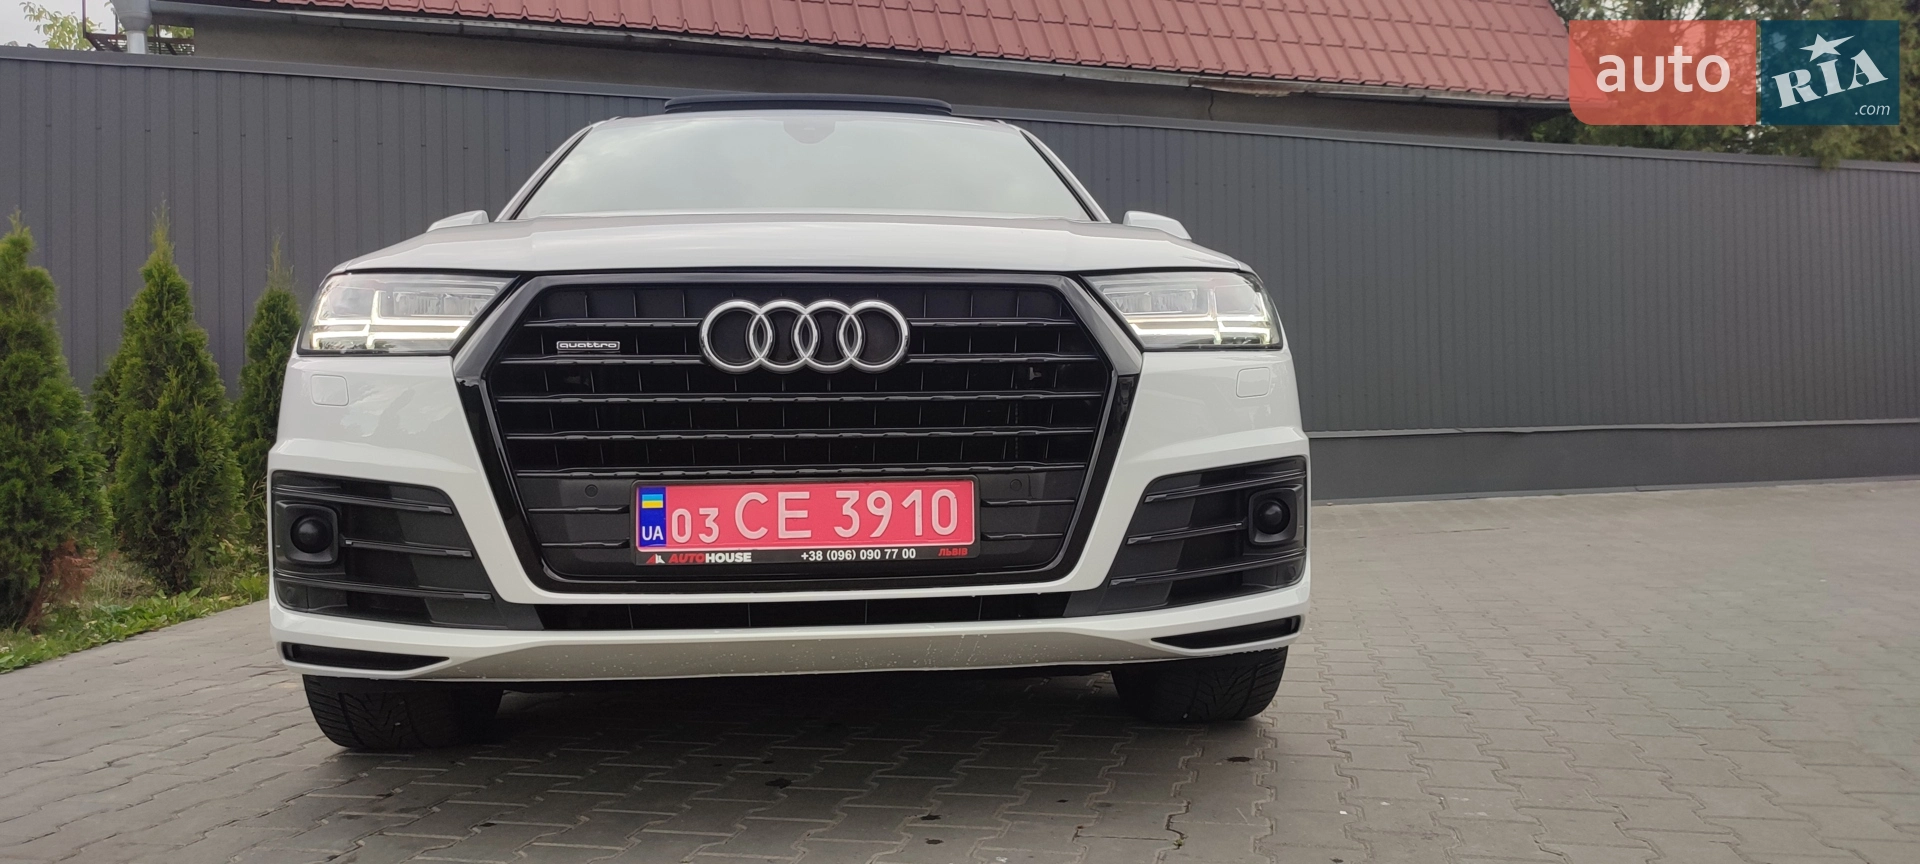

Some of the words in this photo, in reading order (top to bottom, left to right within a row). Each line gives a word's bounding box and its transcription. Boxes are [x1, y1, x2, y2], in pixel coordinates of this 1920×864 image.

[672, 508, 719, 543] 03
[734, 491, 812, 540] CE
[834, 489, 958, 538] 3910
[642, 525, 664, 541] UA
[669, 552, 752, 563] AUTOHOUSE
[801, 550, 823, 562] +38
[826, 549, 857, 561] (096)
[860, 549, 881, 560] 090
[884, 548, 899, 560] 77
[902, 548, 916, 559] 00
